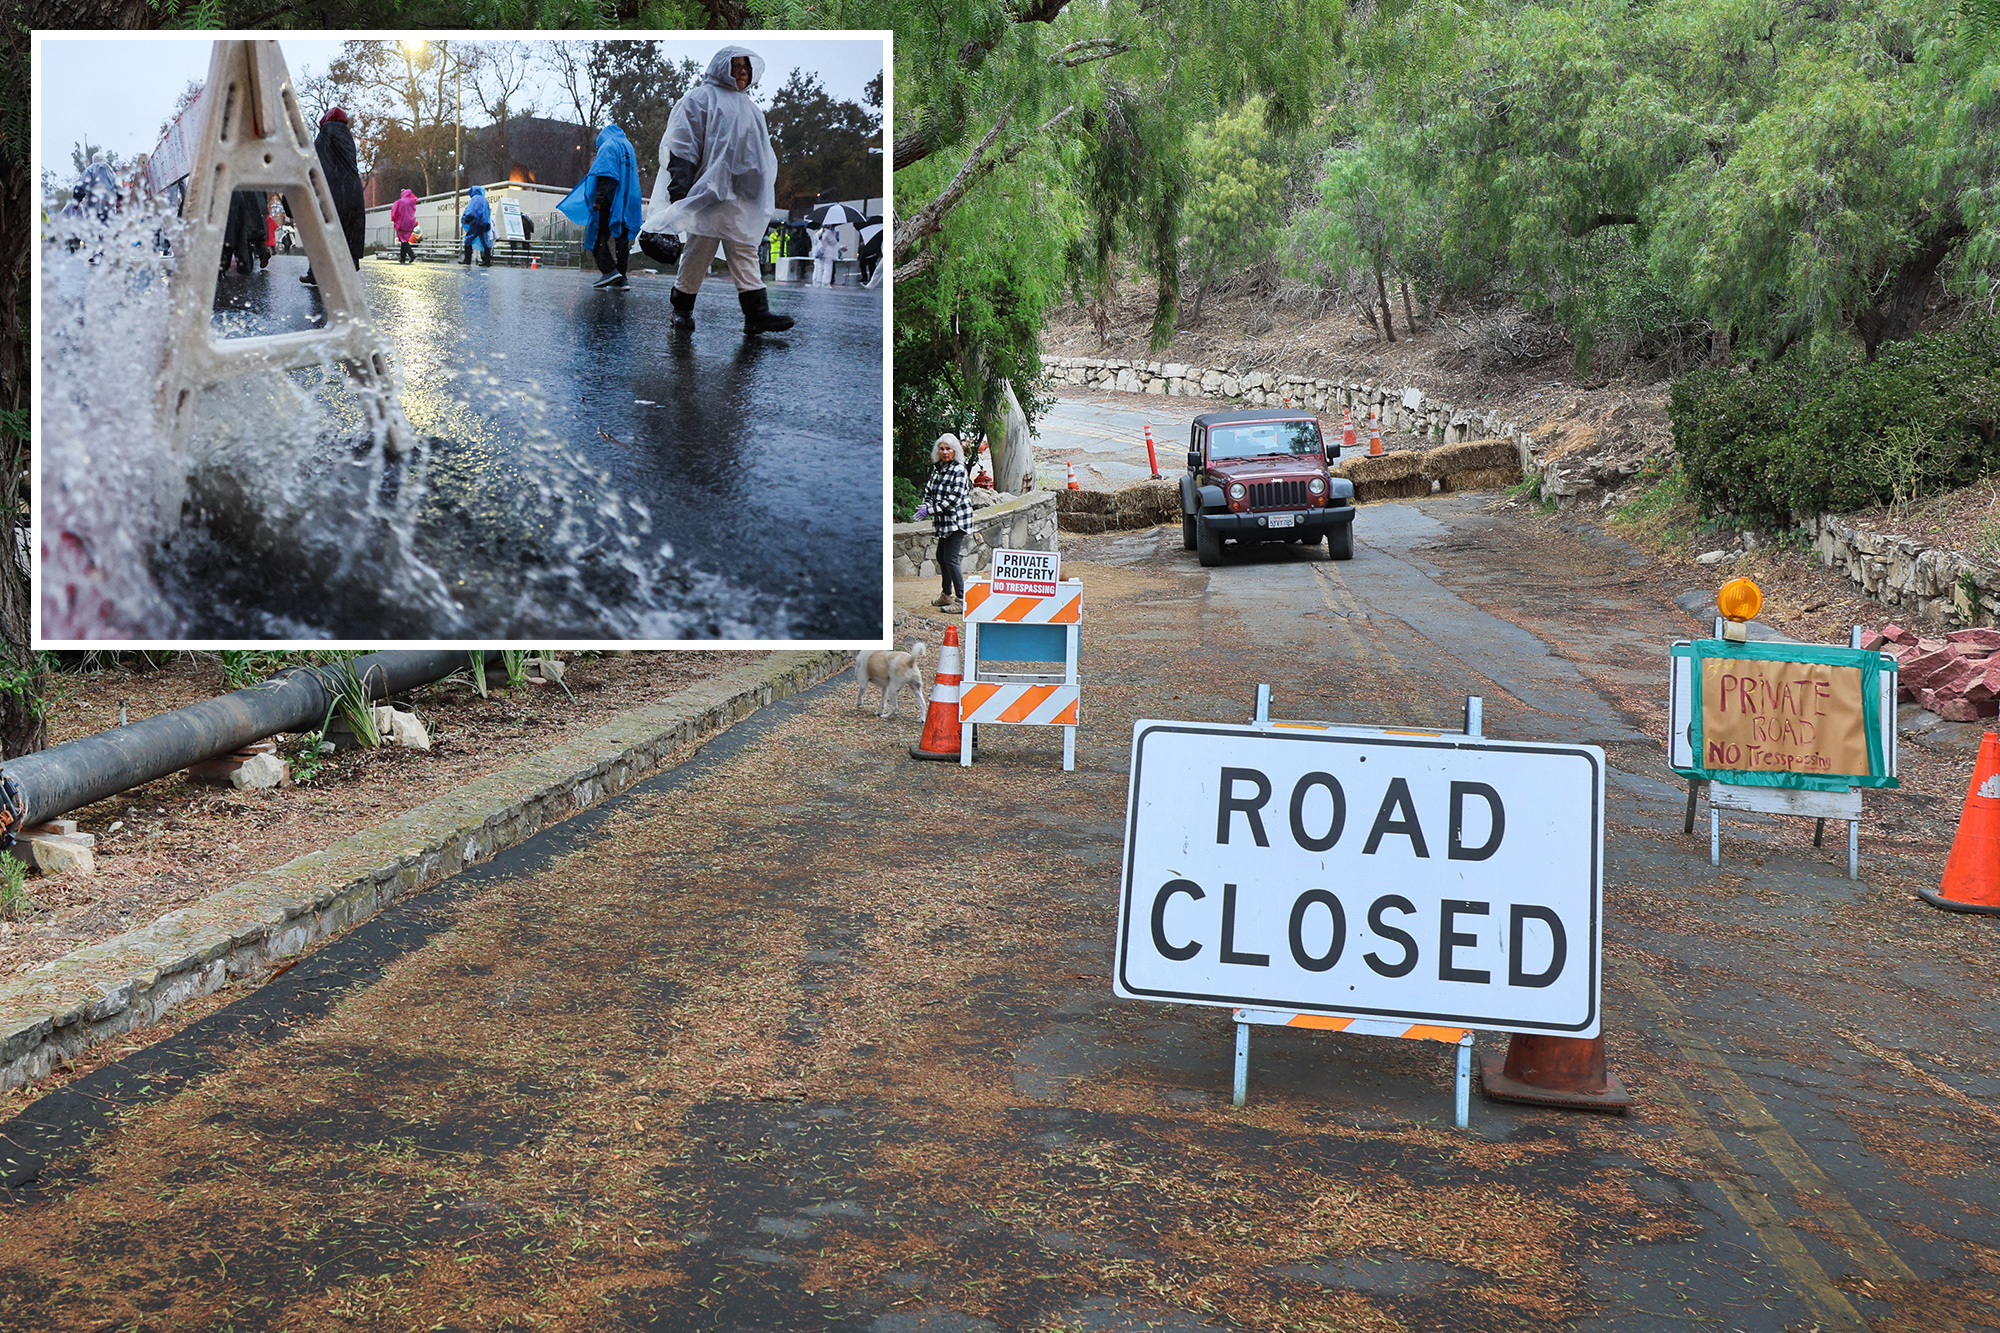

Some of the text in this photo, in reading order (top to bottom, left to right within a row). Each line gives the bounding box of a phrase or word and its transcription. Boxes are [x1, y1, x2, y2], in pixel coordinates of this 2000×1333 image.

[1003, 554, 1049, 568] PRIVATE
[996, 566, 1055, 580] PROPERTY
[993, 581, 1055, 594] NO TRESPASSING
[1753, 716, 1816, 746] ROAD
[1708, 741, 1741, 764] NO
[1216, 766, 1506, 861] ROAD
[1150, 878, 1567, 988] CLOSED
